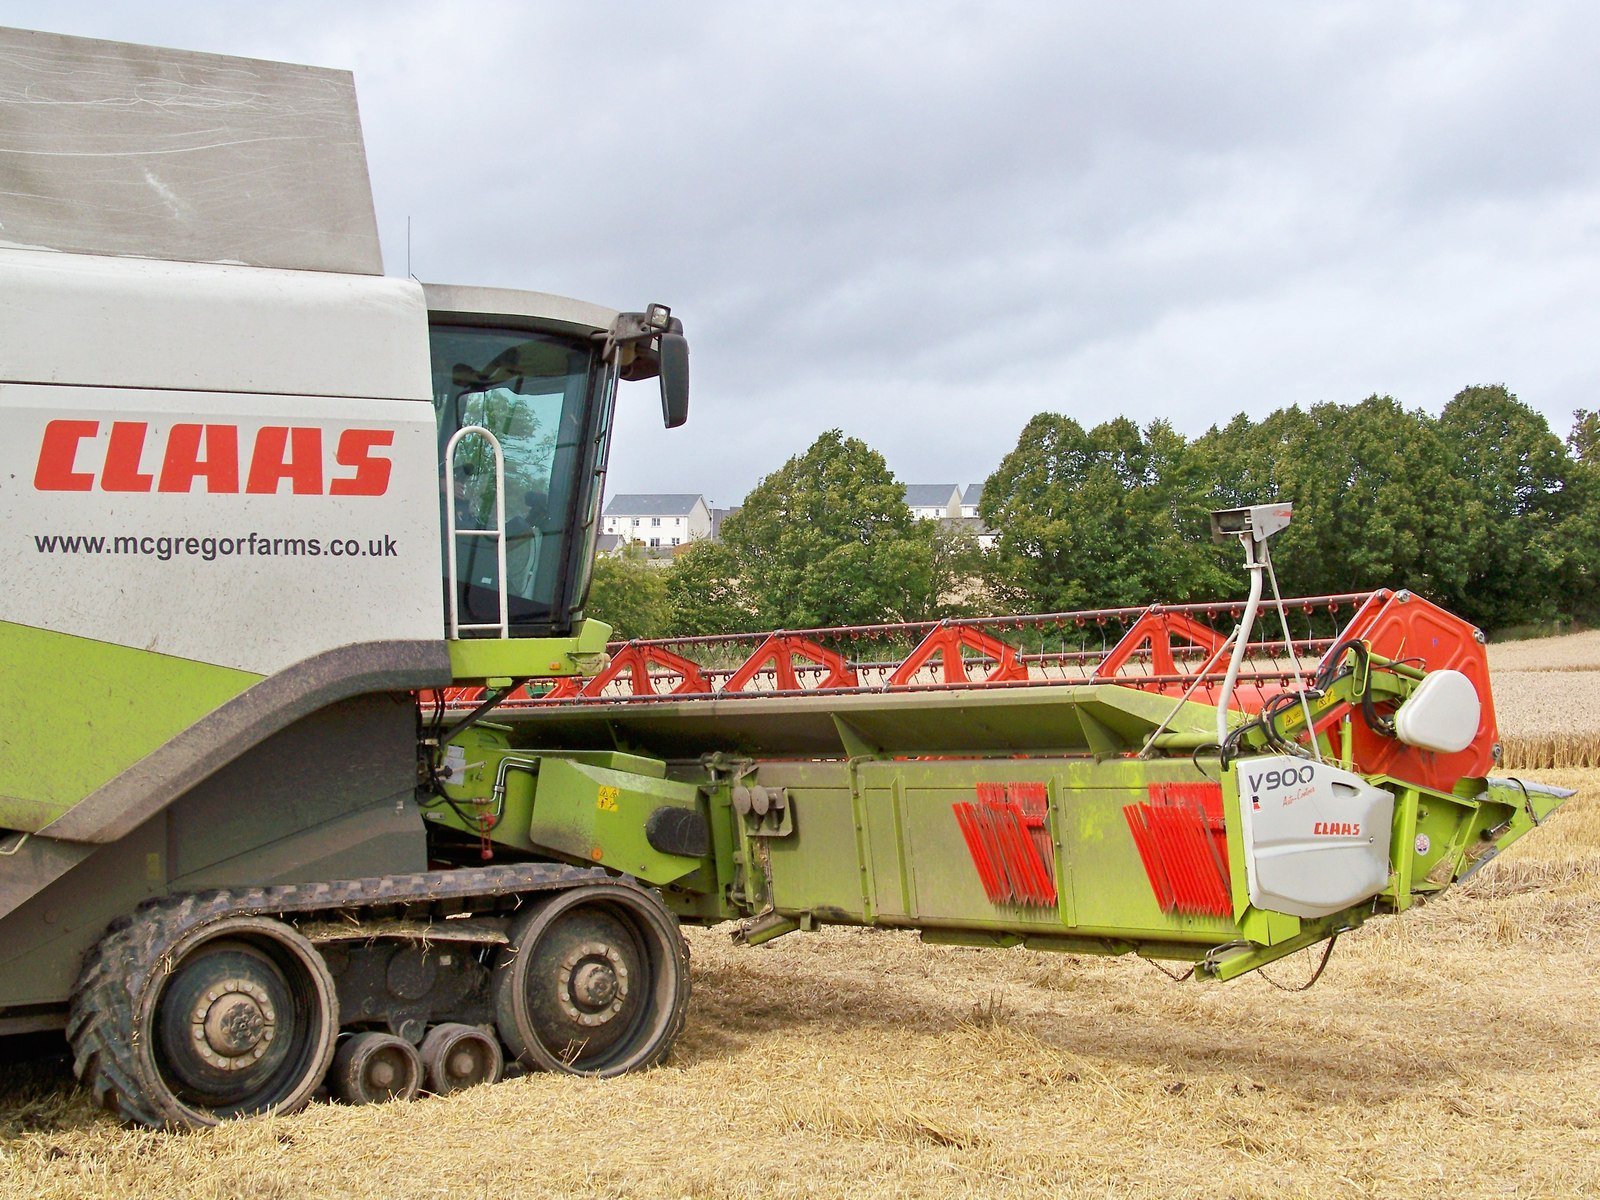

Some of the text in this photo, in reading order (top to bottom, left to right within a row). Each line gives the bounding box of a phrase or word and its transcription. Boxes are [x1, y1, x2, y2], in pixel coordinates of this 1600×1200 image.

[33, 419, 395, 497] CLAAS
[34, 532, 398, 561] www.mcgregorfarms.co.uk
[1248, 765, 1315, 793] V900
[1313, 822, 1361, 836] CLAAS
